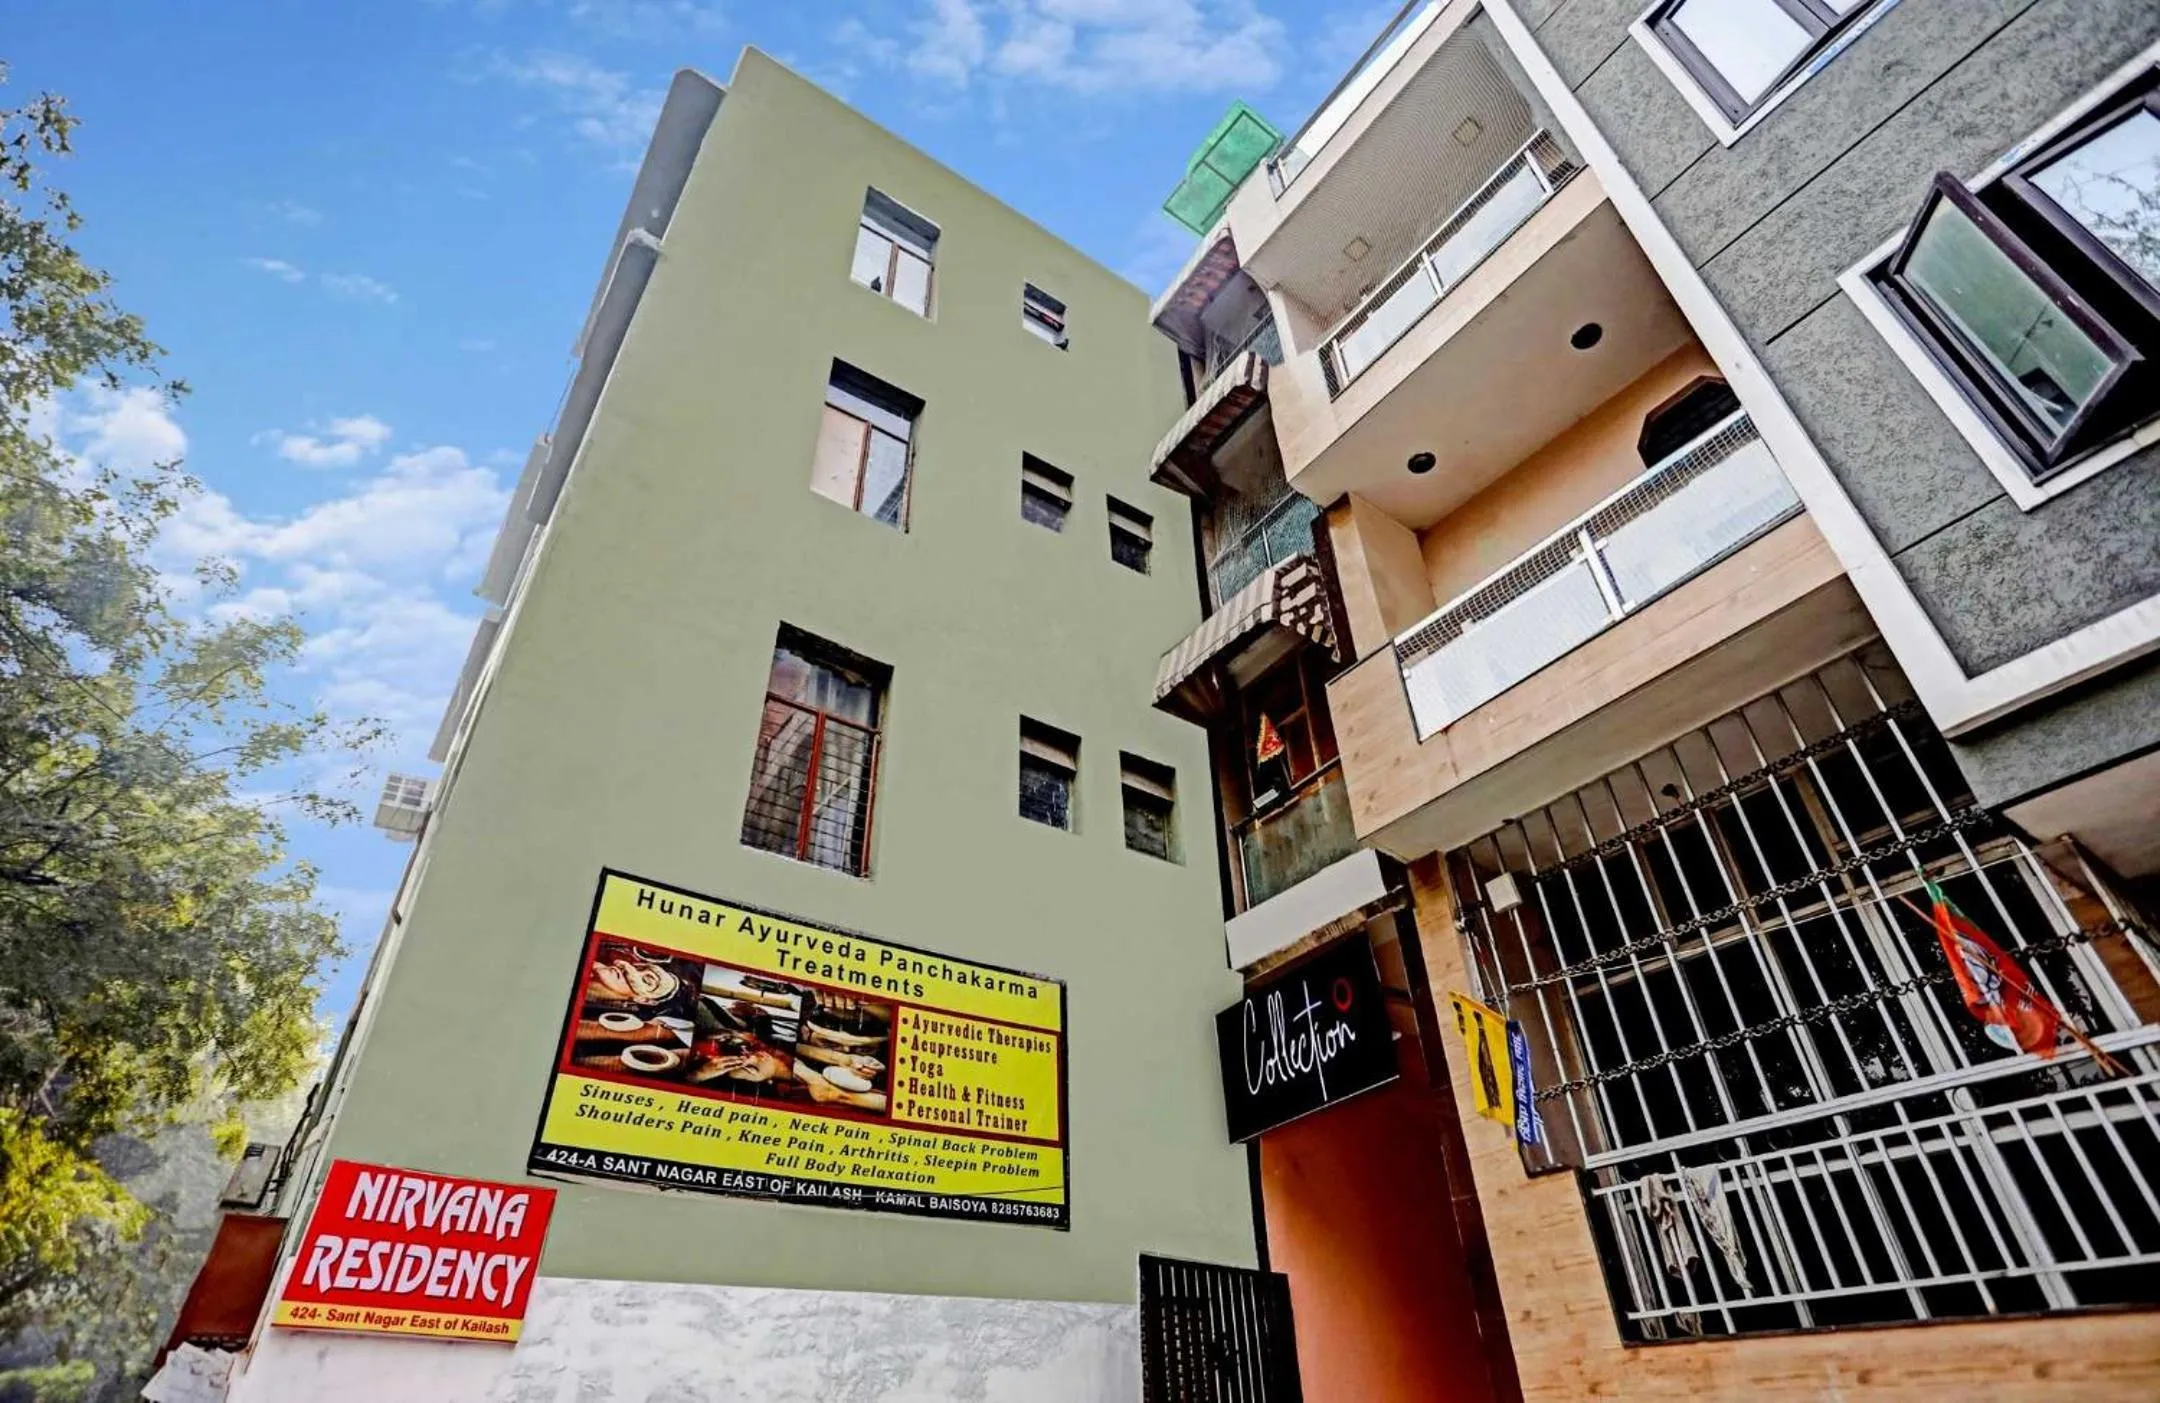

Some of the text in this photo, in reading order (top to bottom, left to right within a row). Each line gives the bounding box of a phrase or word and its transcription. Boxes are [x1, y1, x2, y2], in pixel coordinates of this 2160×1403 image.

[637, 887, 1039, 1000] Hunar Ayurveda Panchakarma
[775, 949, 926, 999] Treatments
[911, 1034, 998, 1065] Acupressure
[912, 1013, 1052, 1054] Ayurvedic Therapies
[1243, 980, 1356, 1102] Collection
[910, 1055, 944, 1079] Yoga
[907, 1099, 1028, 1133] Personal Trainer
[908, 1077, 1026, 1111] Health & Fitness
[575, 1104, 676, 1131] Shoulders
[680, 1120, 722, 1139] Pain
[739, 1129, 782, 1147] Knee
[923, 1154, 978, 1173] Sleepin
[982, 1161, 1040, 1177] Problem
[677, 1100, 723, 1119] Head
[789, 1118, 829, 1135] Neck
[834, 1124, 871, 1140] Pain
[887, 1132, 938, 1151] Spinal
[941, 1140, 977, 1154] Back
[981, 1144, 1039, 1161] Problem
[546, 1148, 598, 1169] 424-A
[602, 1157, 653, 1176] SANT
[656, 1164, 718, 1185] NAGAR
[722, 1173, 766, 1190] EAST
[770, 1178, 791, 1194] OF
[796, 1182, 862, 1202] KAILASH
[875, 1190, 926, 1208] KAMAL
[929, 1197, 988, 1213] BAISOYA
[765, 1152, 936, 1185] Full Body Relaxation
[345, 1170, 530, 1242] NIRVANA
[301, 1233, 531, 1309] RESIDENCY
[326, 1309, 360, 1324] Sant
[363, 1312, 406, 1329] Nagar
[410, 1315, 441, 1329] East
[444, 1317, 458, 1330] of
[460, 1320, 510, 1335] Kailash
